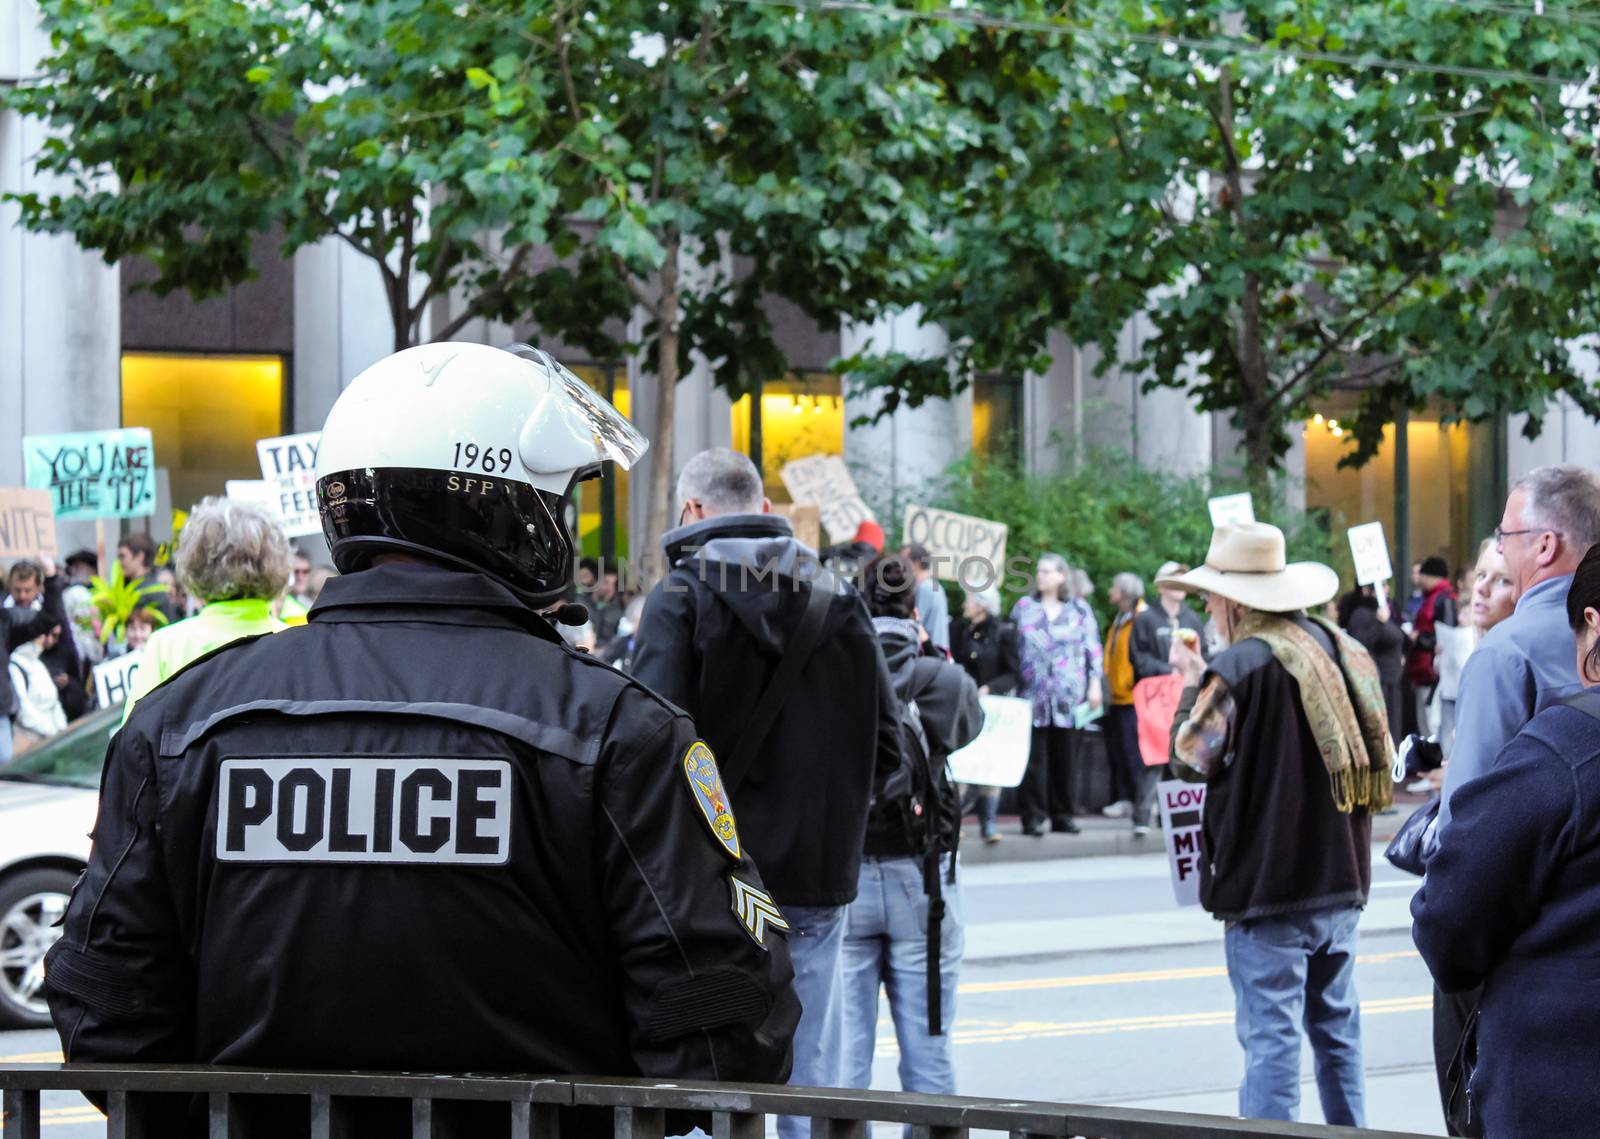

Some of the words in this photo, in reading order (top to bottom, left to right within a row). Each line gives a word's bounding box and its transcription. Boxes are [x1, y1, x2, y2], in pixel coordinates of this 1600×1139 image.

[36, 443, 105, 483] YOU
[111, 445, 148, 470] ARE
[453, 442, 513, 474] 1969
[50, 478, 99, 511] THE
[909, 511, 1004, 558] OCCUPY
[226, 768, 502, 854] POLICE
